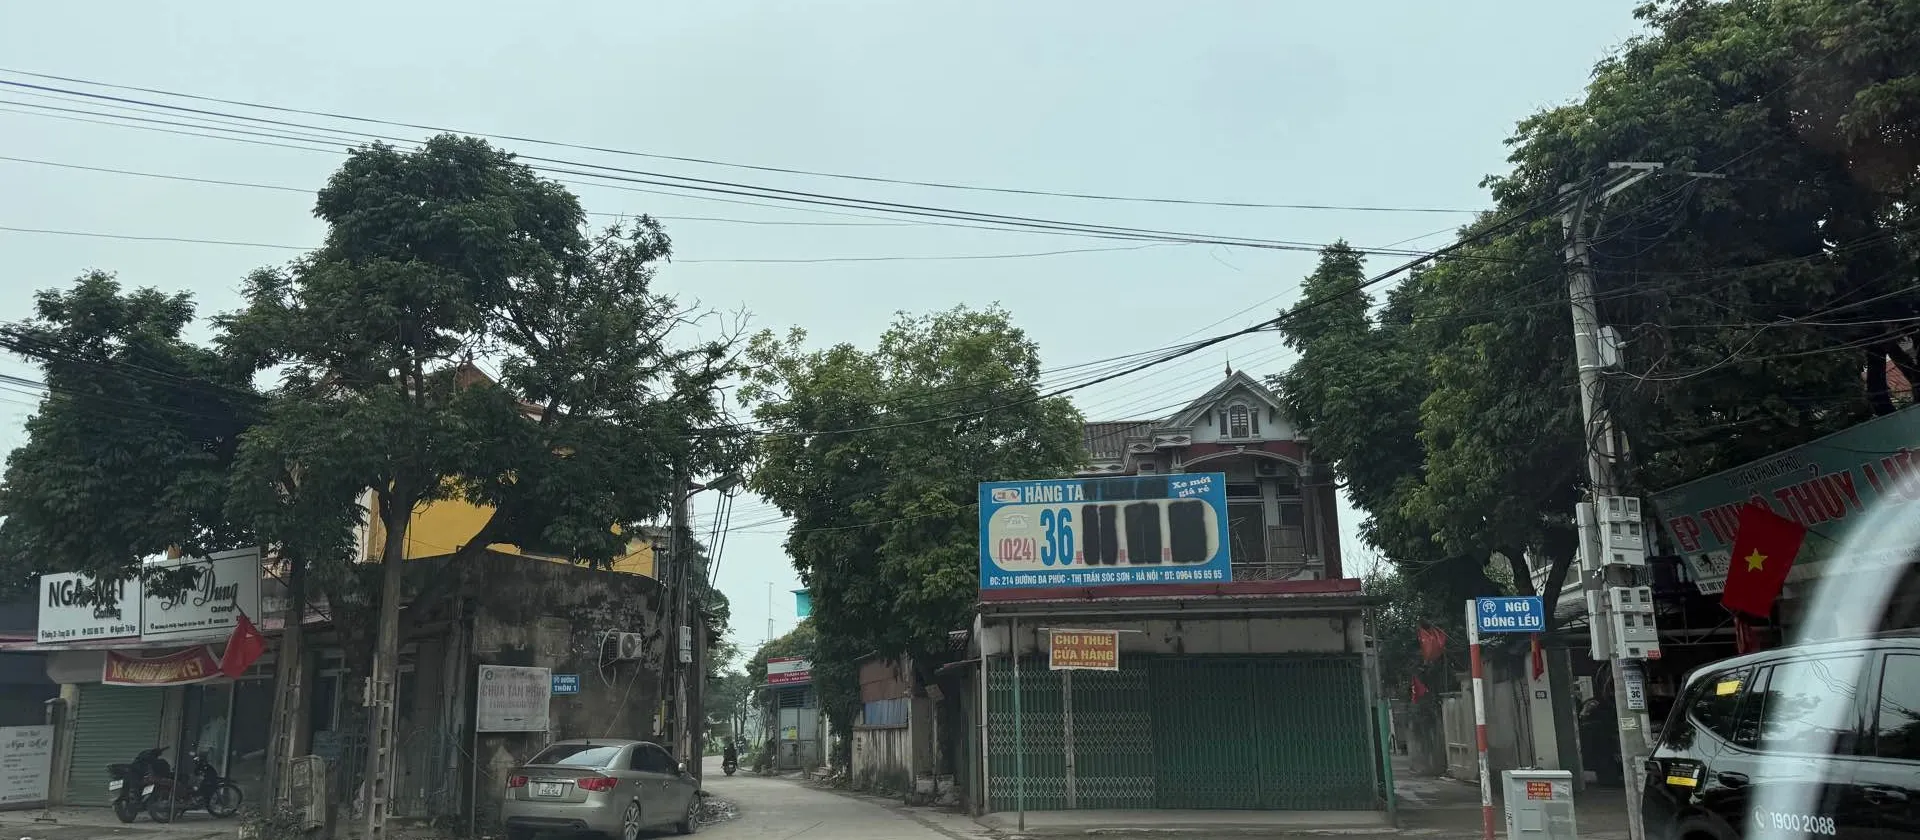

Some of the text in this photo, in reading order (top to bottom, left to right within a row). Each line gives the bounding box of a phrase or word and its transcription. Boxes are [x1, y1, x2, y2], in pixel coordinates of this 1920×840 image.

[1172, 481, 1187, 489] Xe
[1024, 483, 1063, 503] HÃNG
[998, 537, 1037, 565] (024)
[1001, 576, 1014, 585] 214
[1055, 634, 1112, 646] CHO THUÊ
[1053, 647, 1114, 661] CỬA HÀNG
[1769, 812, 1836, 836] 1900 2088
